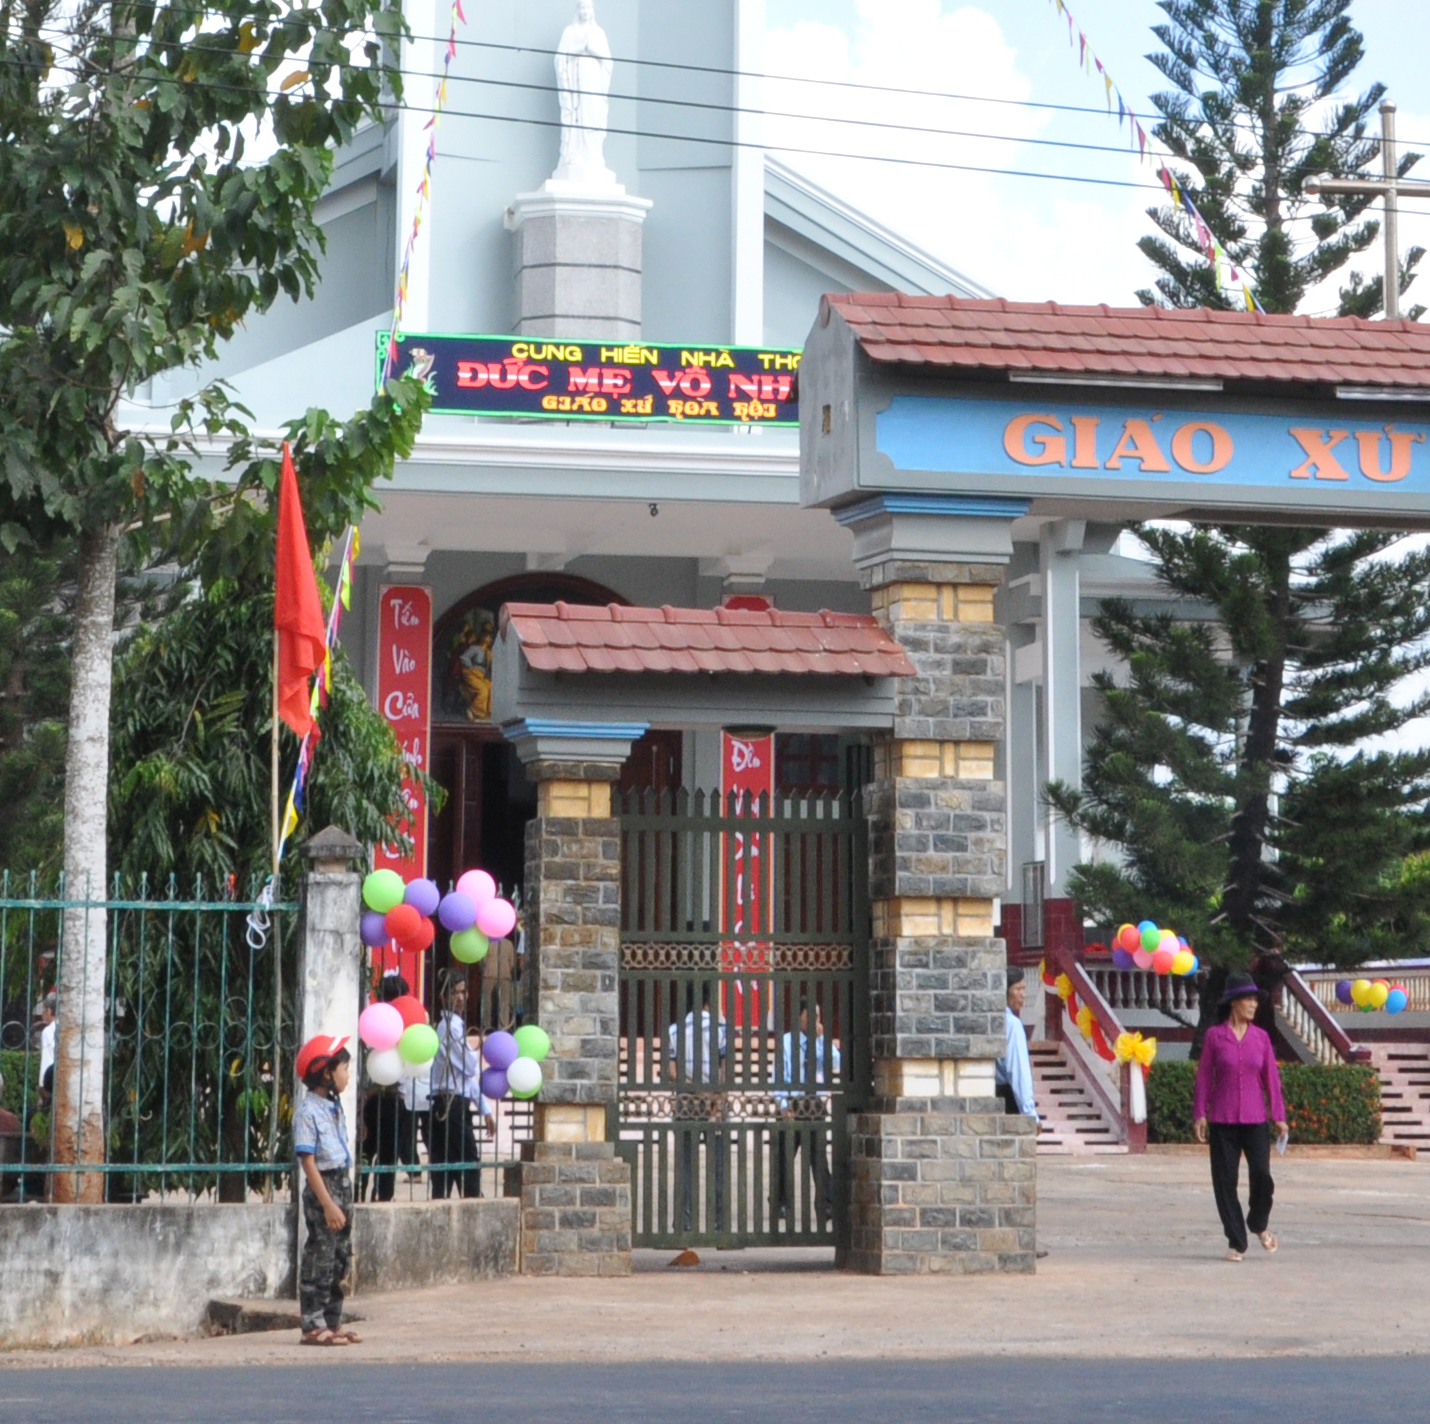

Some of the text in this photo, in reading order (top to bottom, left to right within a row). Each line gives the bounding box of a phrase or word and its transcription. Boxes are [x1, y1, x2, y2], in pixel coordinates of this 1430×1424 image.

[511, 342, 583, 362] CUNG
[600, 344, 659, 366] HIẾN
[680, 348, 735, 368] NHÀ
[456, 356, 550, 390] ĐỨC
[567, 365, 633, 399] MẸ
[651, 364, 712, 398] VÔ
[1002, 412, 1235, 474] GIÁO
[1288, 423, 1428, 482] XỨ
[391, 643, 416, 675] Vào
